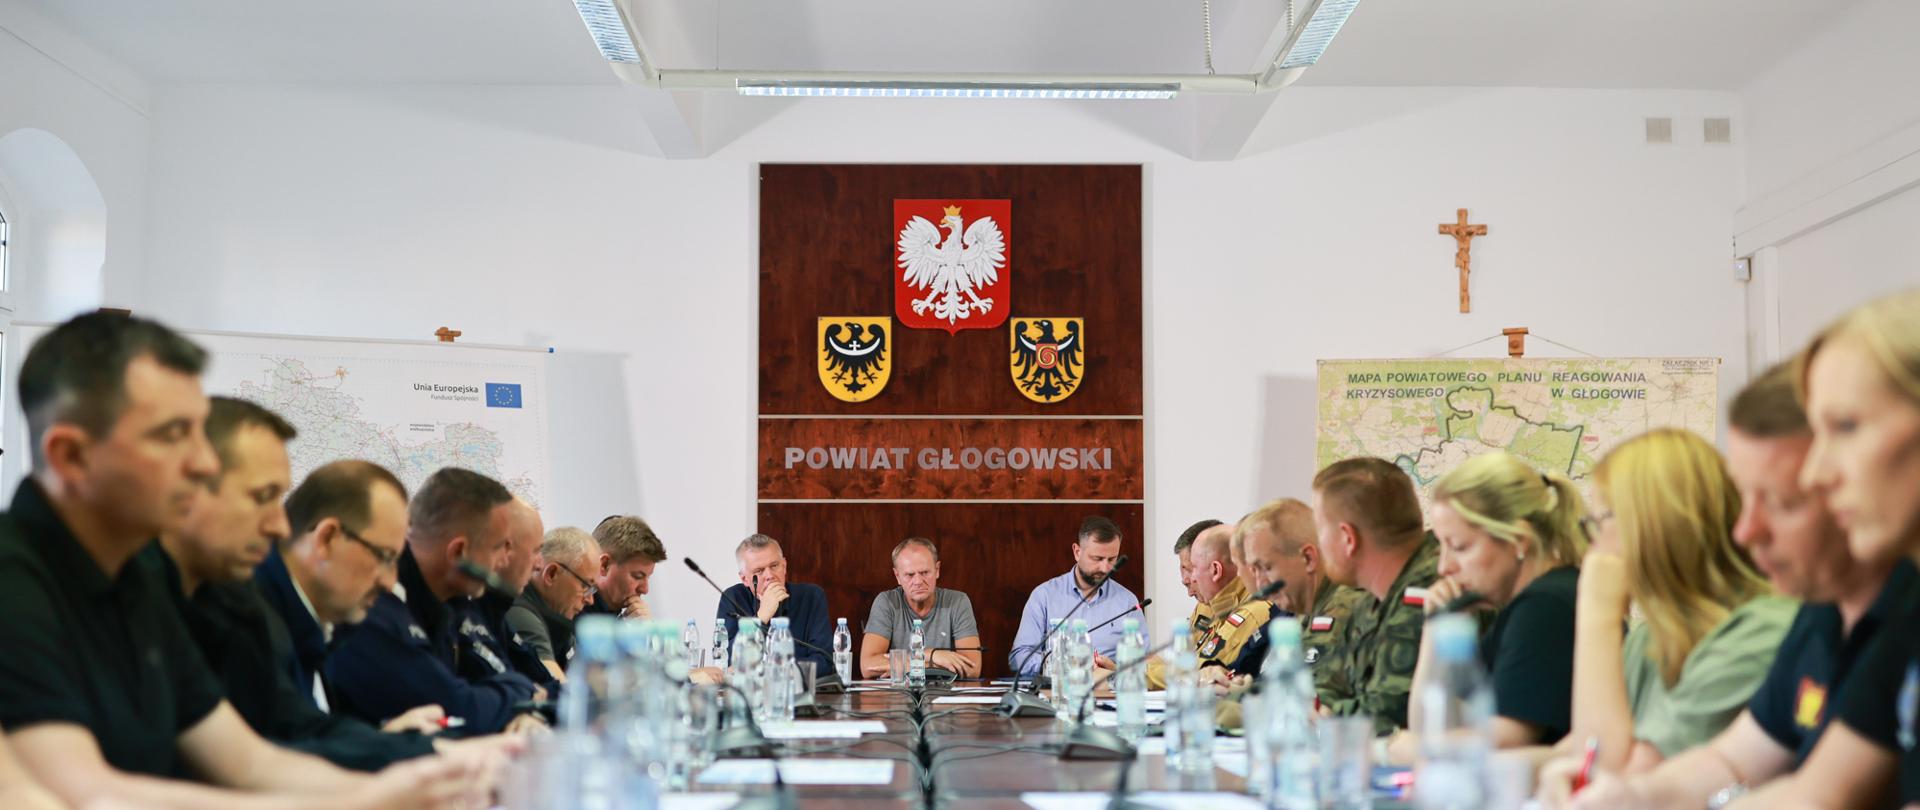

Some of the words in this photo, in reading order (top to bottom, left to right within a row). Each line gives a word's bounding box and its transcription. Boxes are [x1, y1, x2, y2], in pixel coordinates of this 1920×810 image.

[1348, 373, 1382, 384] MAPA
[1386, 371, 1487, 383] POWIATOWEGO
[1497, 372, 1542, 383] PLANU
[1552, 372, 1647, 383] REAGOWANIA
[413, 383, 432, 391] Unia
[433, 384, 479, 394] Europejska
[1346, 387, 1445, 399] KRYZYSOWEGO
[1551, 388, 1564, 399] W
[1571, 388, 1646, 400] GŁOGOWIE
[785, 447, 910, 470] POWIAT
[917, 447, 1112, 470] GŁOGOWSKI
